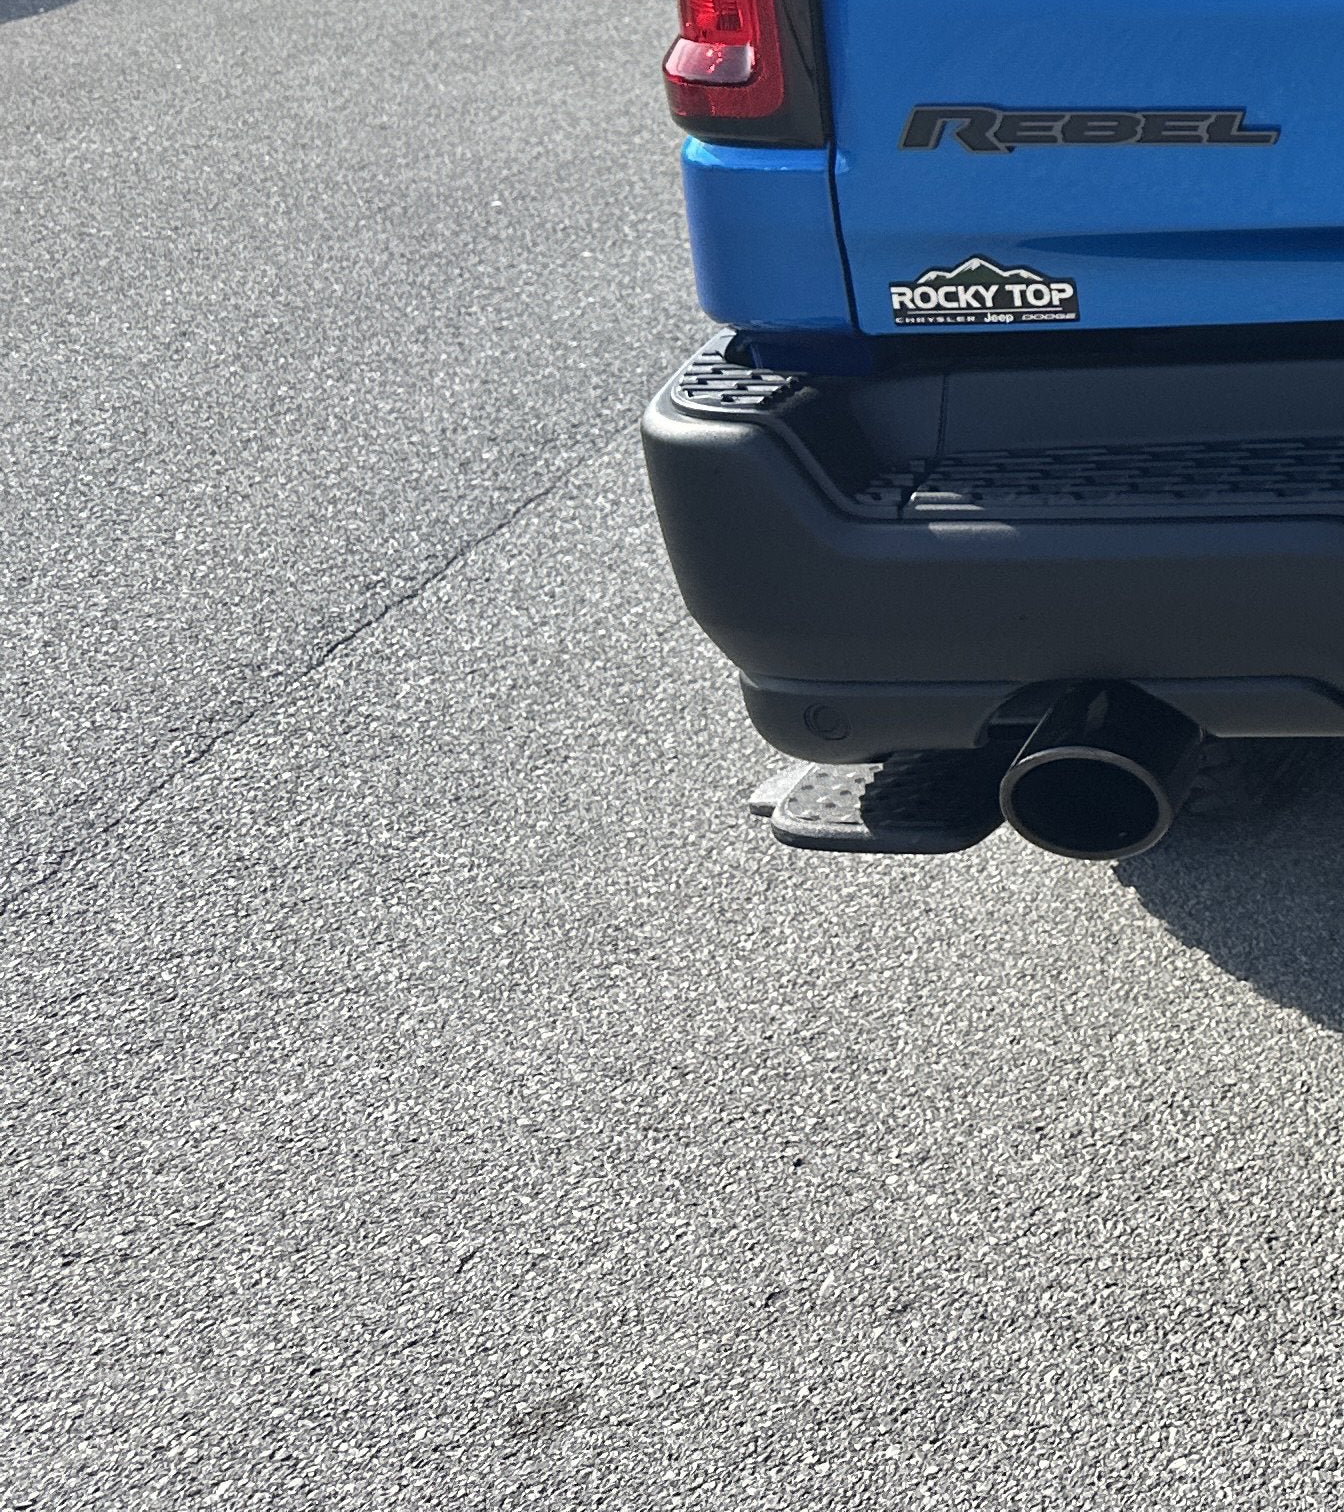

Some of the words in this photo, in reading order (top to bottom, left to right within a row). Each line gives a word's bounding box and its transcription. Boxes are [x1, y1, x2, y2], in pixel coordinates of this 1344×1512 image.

[898, 103, 1281, 155] REBEL
[890, 284, 999, 310] ROCKY
[1005, 282, 1074, 308] TOP
[984, 312, 1014, 324] Jeep
